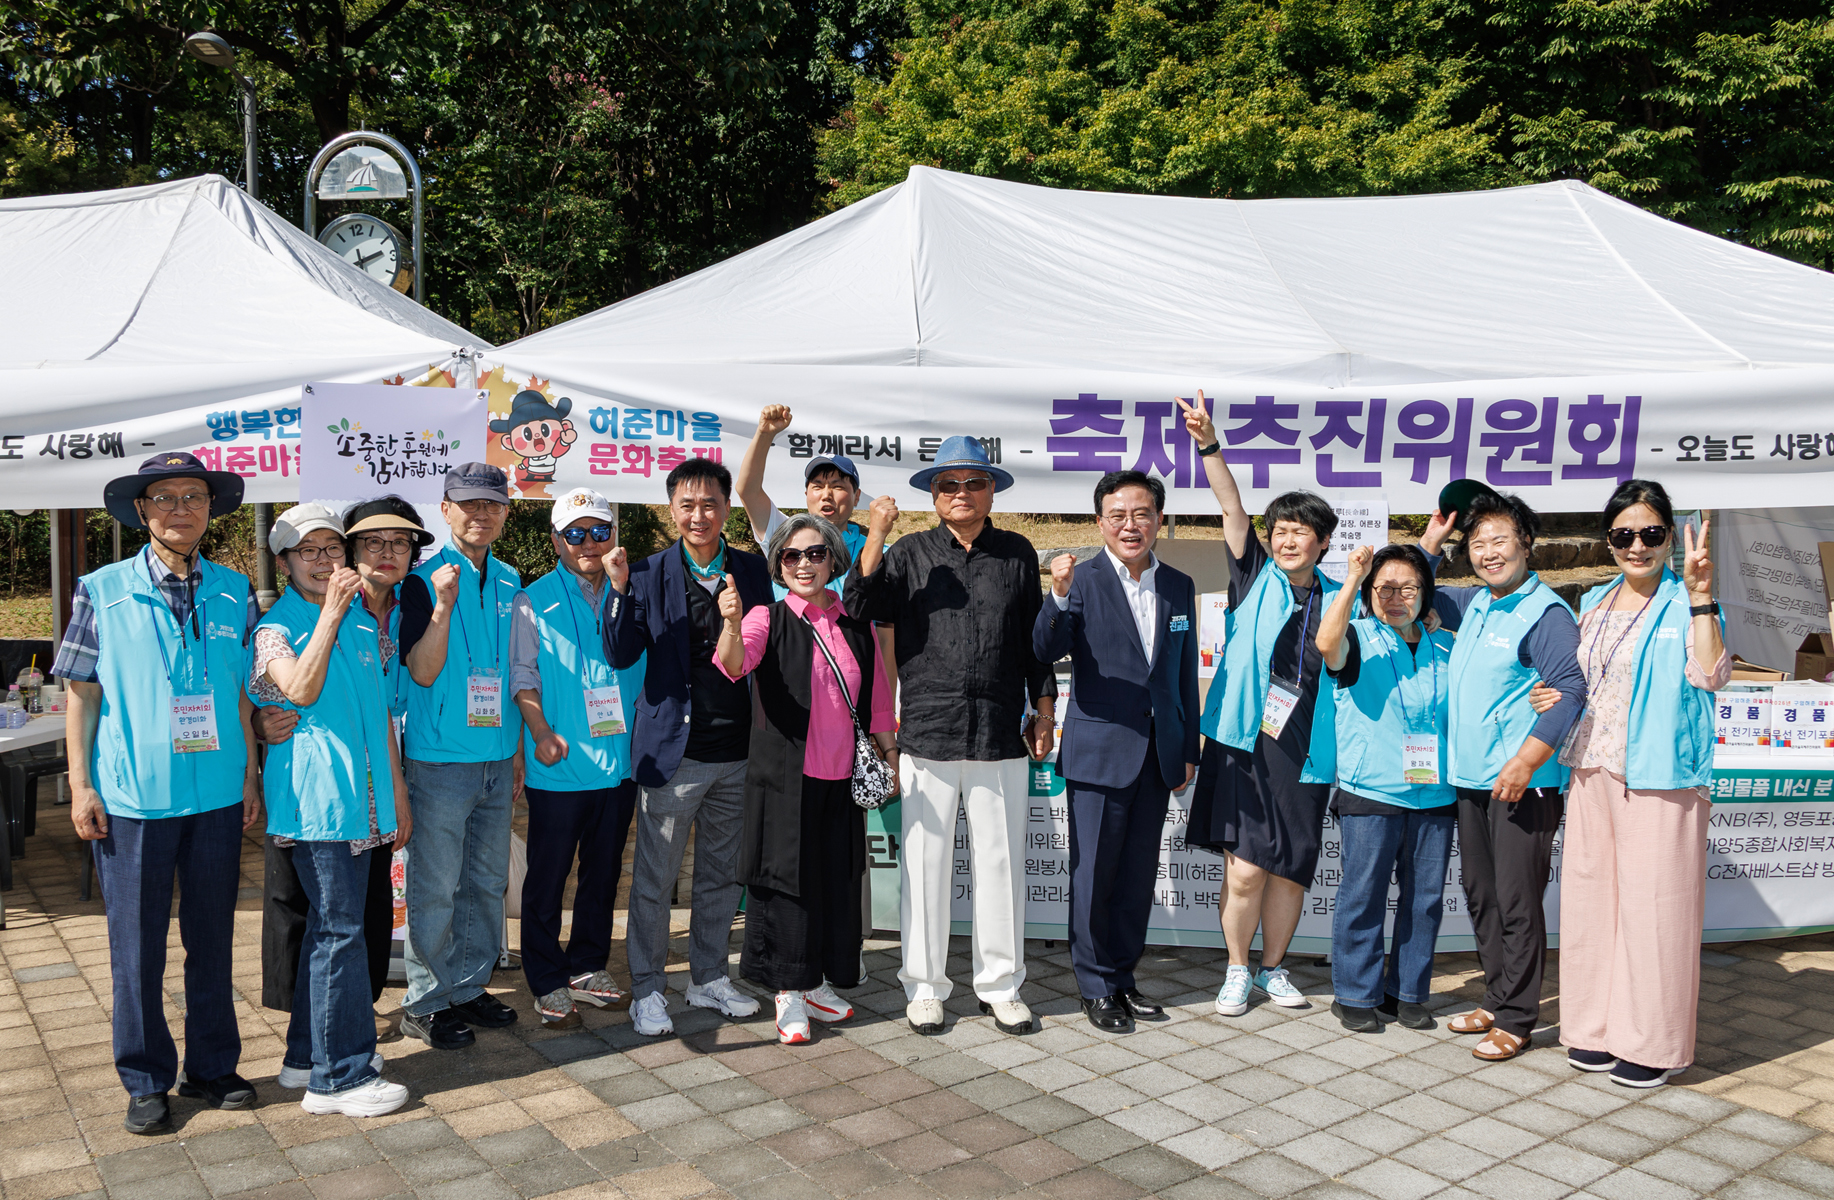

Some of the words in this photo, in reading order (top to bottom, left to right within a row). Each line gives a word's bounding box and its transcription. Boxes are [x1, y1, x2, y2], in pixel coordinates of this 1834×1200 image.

[349, 223, 364, 237] 12
[389, 249, 396, 261] 3
[588, 406, 722, 442] 허준마을
[39, 432, 125, 460] 사랑해
[337, 432, 399, 461] 소중한
[402, 431, 448, 460] 후원에
[788, 433, 901, 461] 함께라서
[1047, 393, 1642, 488] 축제추진위원회
[1676, 434, 1755, 461] 오늘도
[368, 456, 452, 484] 감사합니다
[471, 685, 499, 693] 주민자치회
[173, 704, 212, 714] 주민자치회
[588, 697, 618, 707] 주민자치회
[1773, 778, 1811, 797] 내신
[1813, 779, 1834, 797] 분
[1783, 811, 1834, 827] 영등포
[1705, 862, 1819, 880] G전자베스트샵
